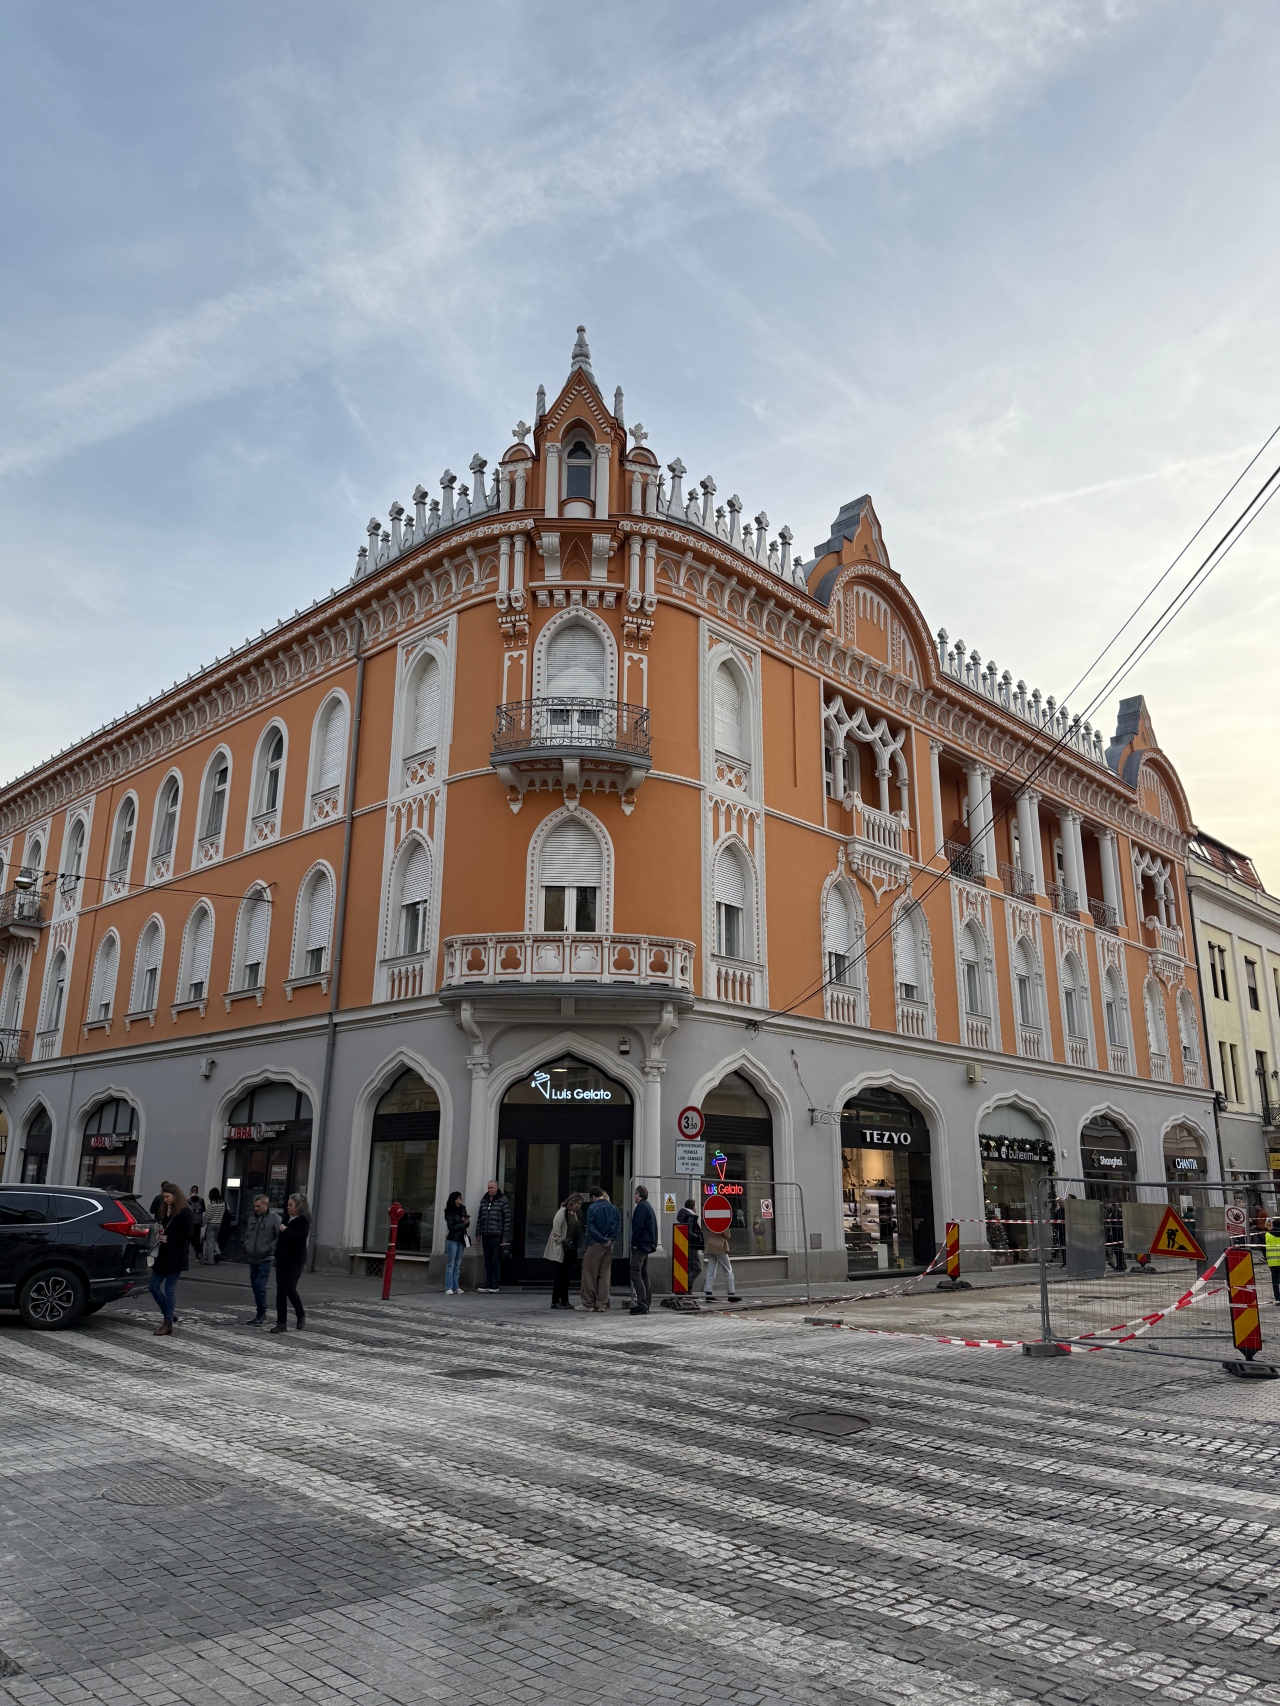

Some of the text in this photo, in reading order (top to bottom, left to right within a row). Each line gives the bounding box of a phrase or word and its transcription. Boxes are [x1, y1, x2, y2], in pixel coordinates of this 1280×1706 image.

[552, 1089, 611, 1099] Luis Gelato
[230, 1126, 254, 1139] LIBRA
[863, 1130, 911, 1145] TEZYO
[1100, 1155, 1122, 1168] Shanghai
[704, 1184, 743, 1194] Luis Gelato
